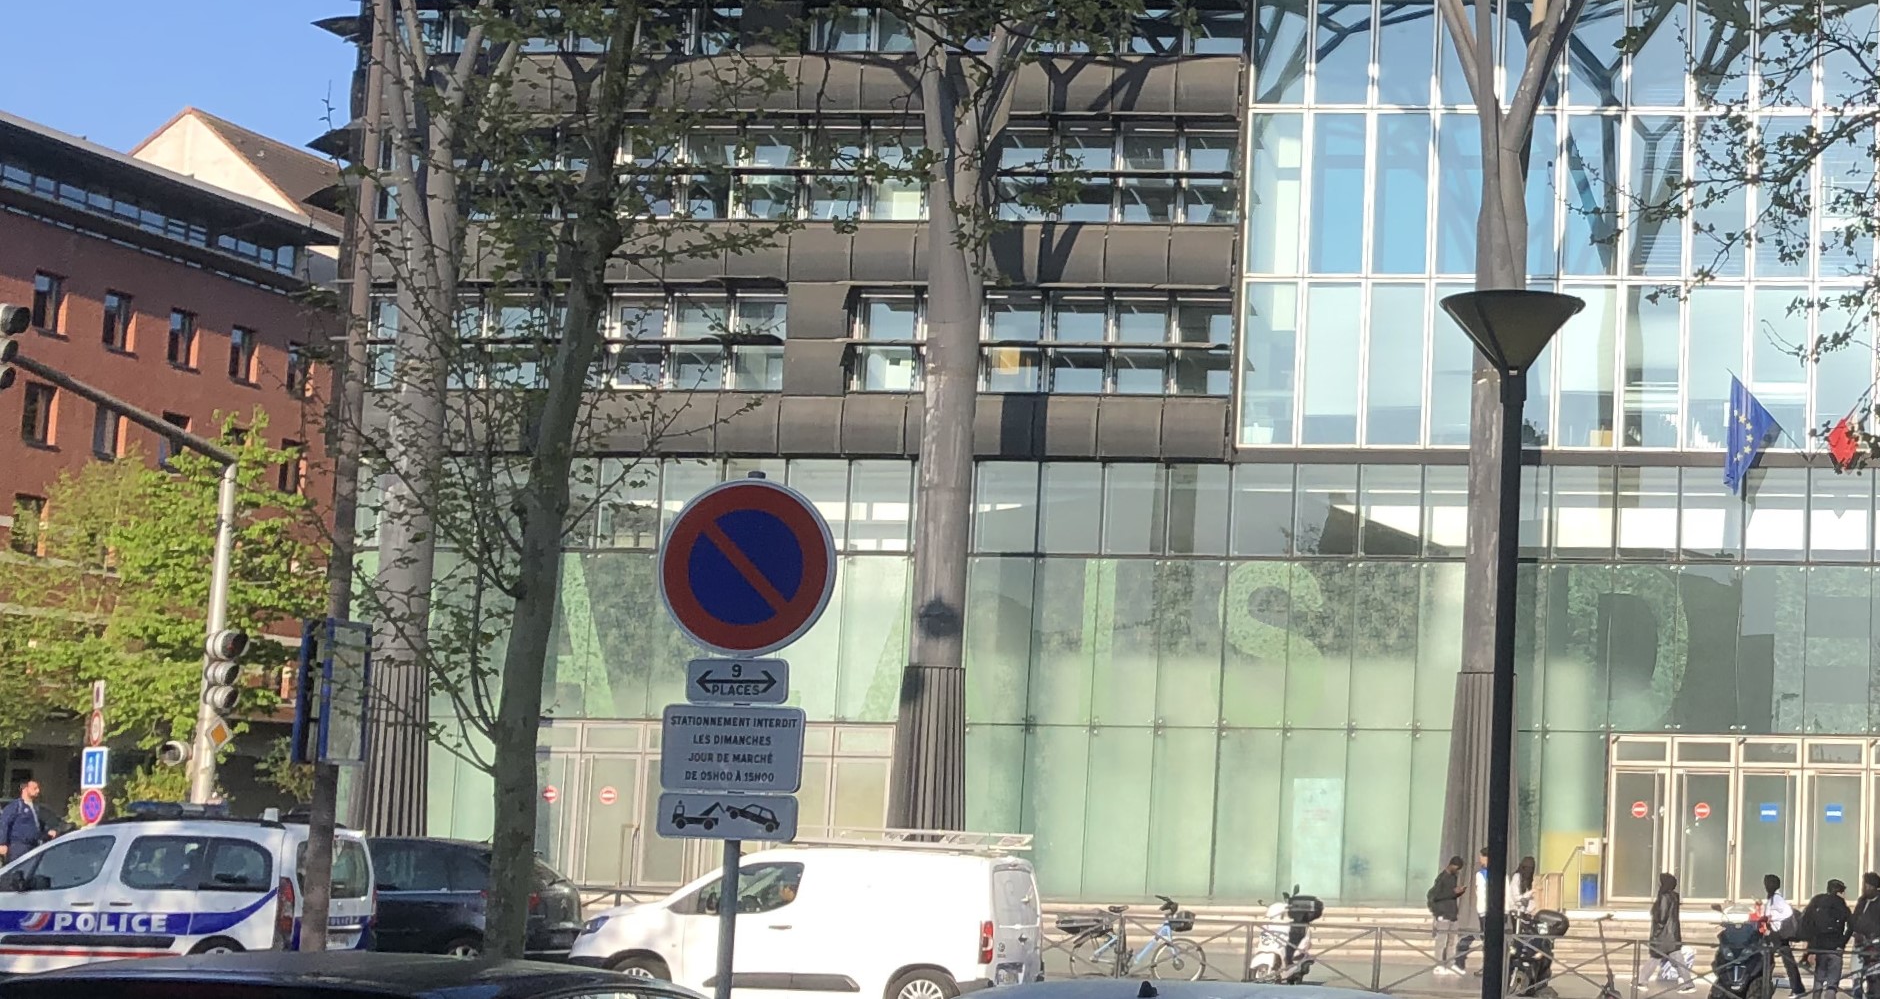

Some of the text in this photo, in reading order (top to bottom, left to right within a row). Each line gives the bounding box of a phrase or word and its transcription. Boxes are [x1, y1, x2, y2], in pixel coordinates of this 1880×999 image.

[1566, 562, 1880, 734] DE
[731, 663, 742, 678] 9
[711, 684, 760, 696] PLACES
[670, 715, 798, 729] STATIONNEMENT INTERDIT
[693, 734, 772, 746] LES DIMANCHES
[687, 751, 773, 764] JOUR DE MARCHÉ
[684, 770, 698, 781] DE
[700, 770, 733, 782] 05H00
[744, 771, 775, 782] 15H00
[52, 912, 169, 933] POLICE
